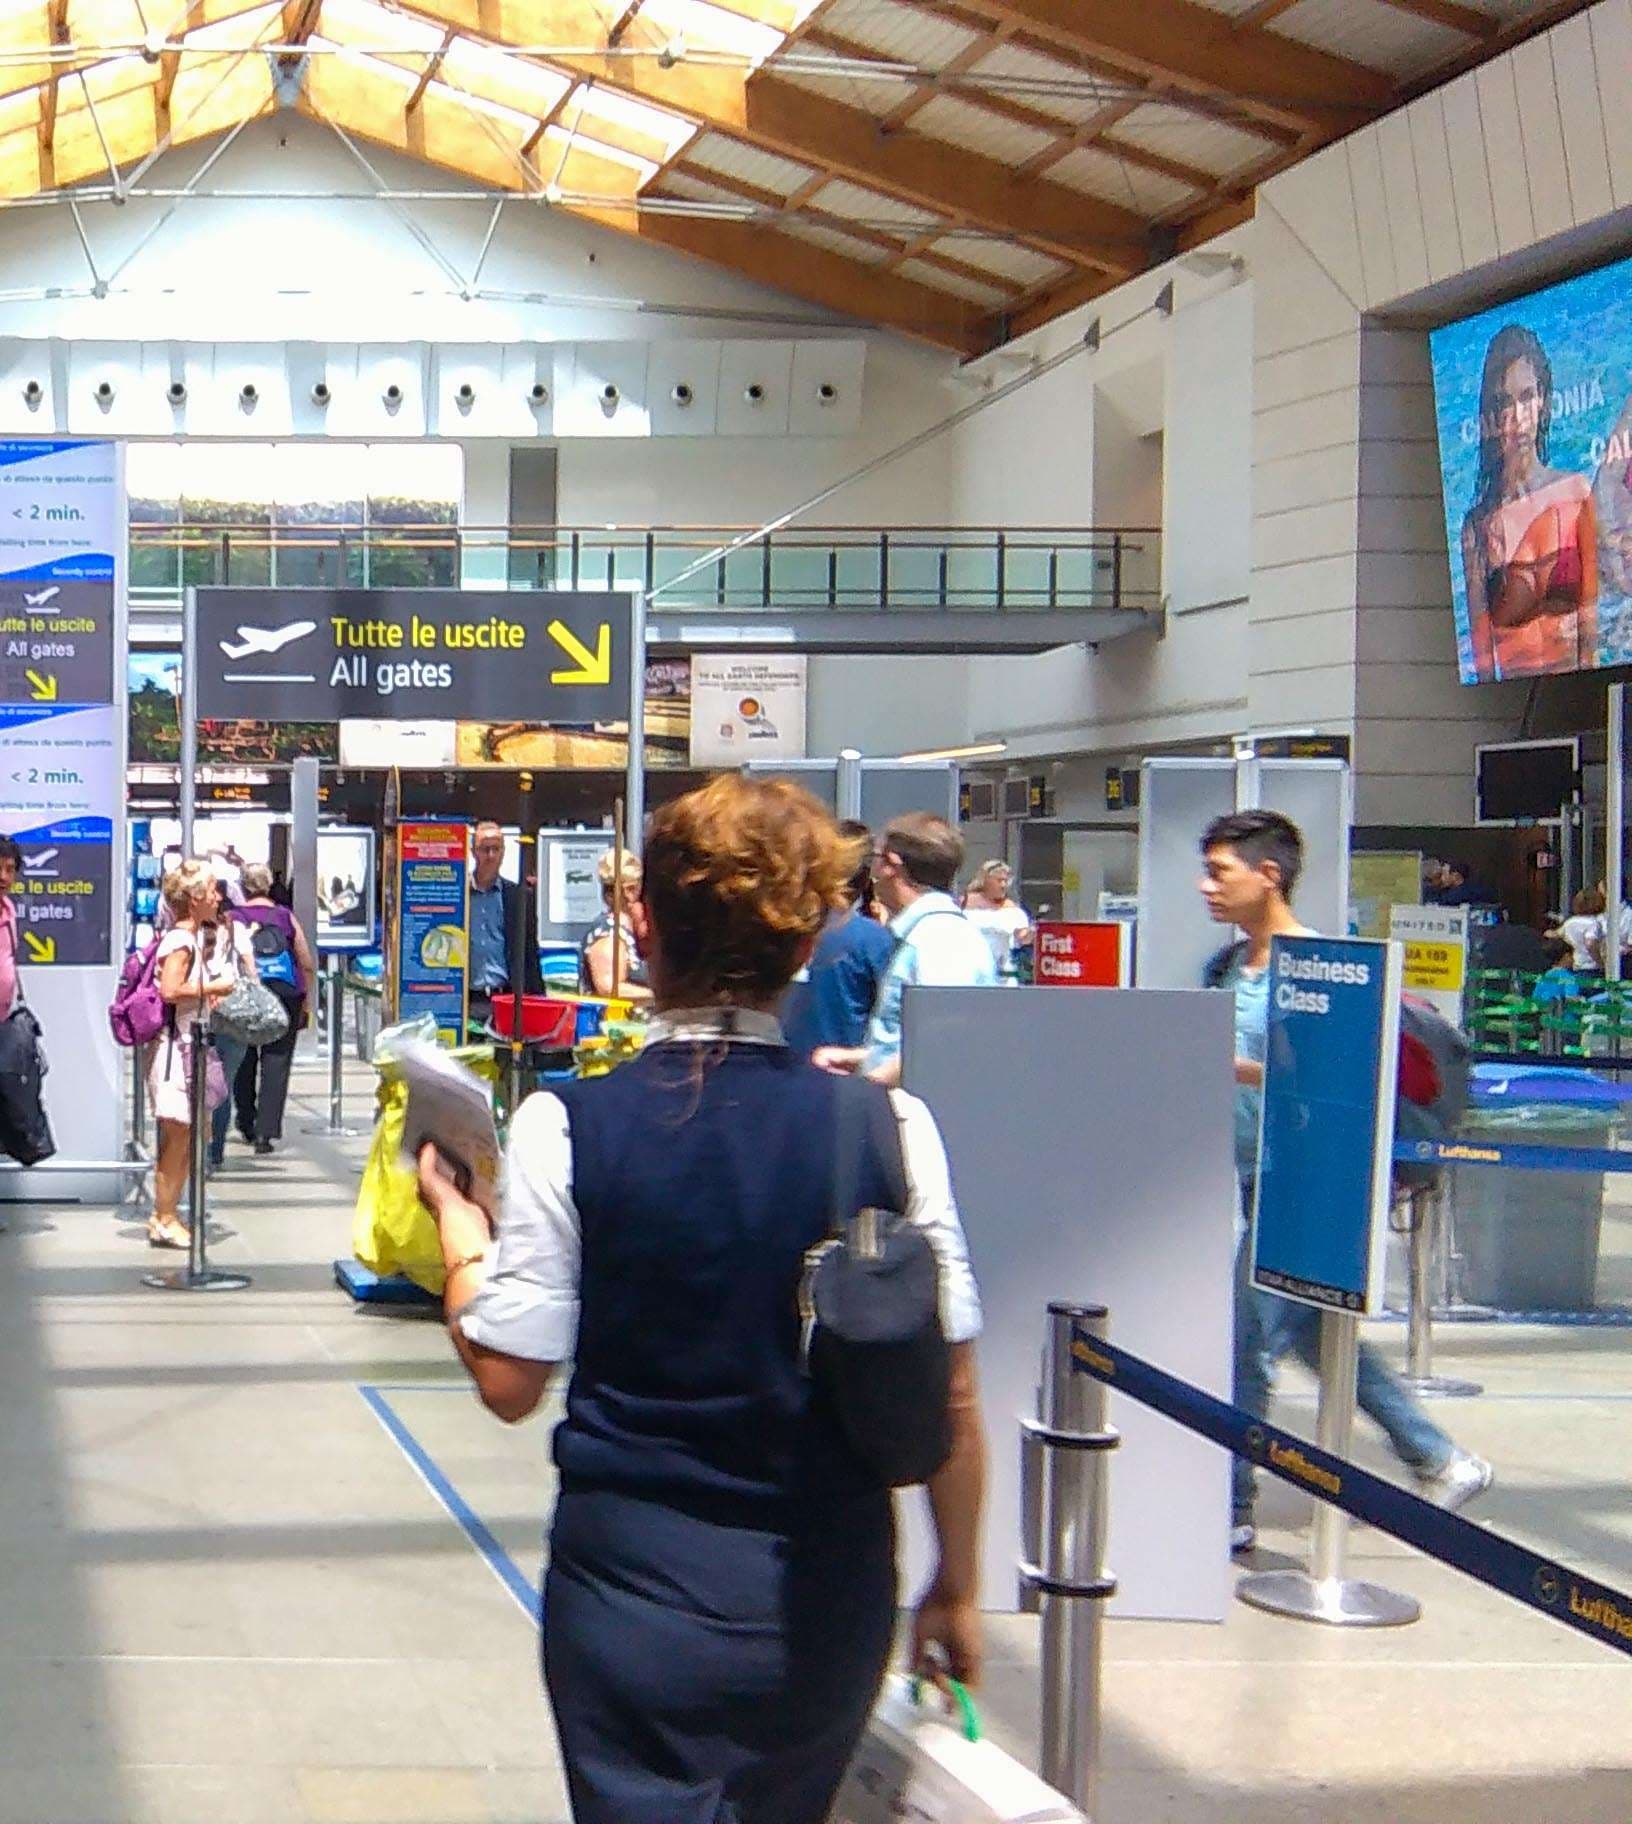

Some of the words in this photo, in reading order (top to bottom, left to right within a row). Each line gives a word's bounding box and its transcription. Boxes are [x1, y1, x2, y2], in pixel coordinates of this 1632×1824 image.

[30, 505, 40, 520] 2
[46, 504, 85, 520] min.
[31, 617, 46, 632] le
[49, 617, 96, 633] uscite
[330, 616, 404, 648] Tutte
[411, 614, 436, 648] le
[444, 616, 526, 648] uscite
[6, 640, 28, 657] All
[30, 642, 75, 660] gates
[329, 654, 367, 688] All
[376, 658, 453, 695] gates
[28, 768, 39, 783] 2
[44, 768, 84, 784] min.
[29, 879, 44, 894] le
[47, 880, 94, 895] uscite
[29, 904, 73, 922] gates
[1040, 932, 1074, 954] First
[1040, 955, 1082, 979] Class
[1278, 951, 1370, 985] Business
[1274, 982, 1331, 1015] Class
[1438, 1142, 1502, 1161] Lufthansa
[1269, 1439, 1341, 1496] Lufthansa
